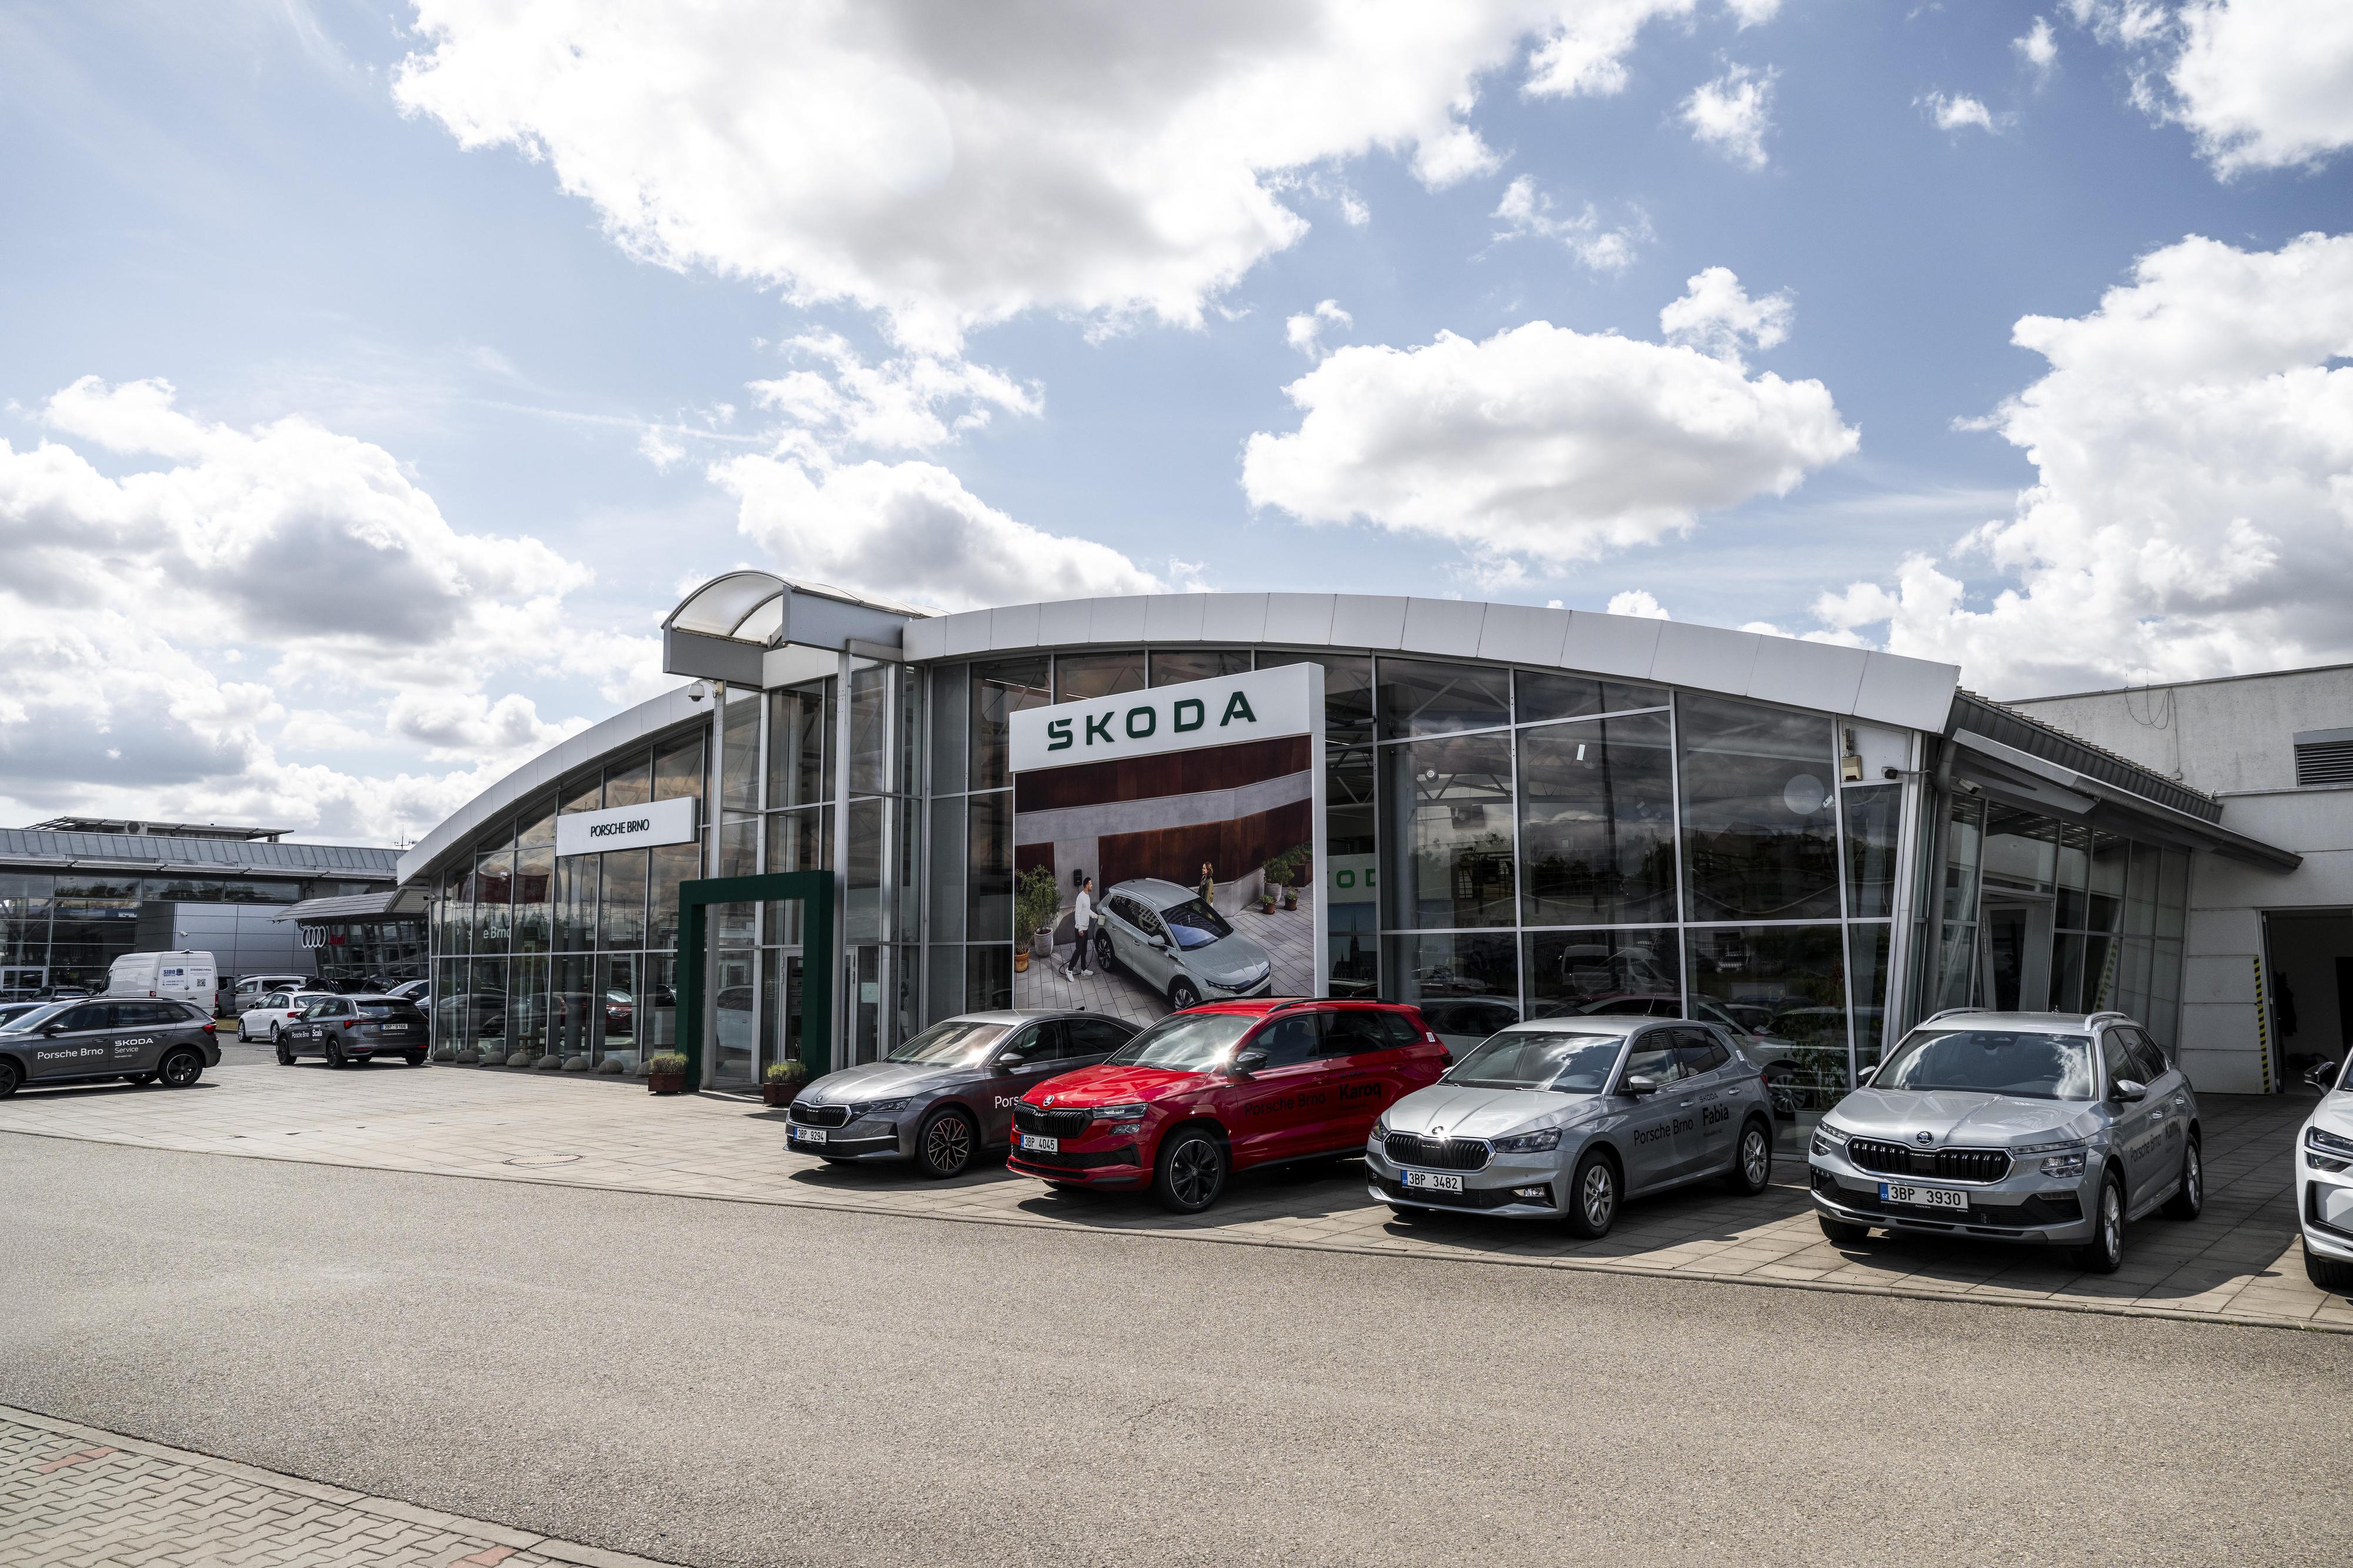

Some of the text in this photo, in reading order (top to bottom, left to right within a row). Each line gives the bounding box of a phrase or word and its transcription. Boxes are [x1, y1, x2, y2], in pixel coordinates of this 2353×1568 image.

[591, 819, 649, 838] PORSCHE BRNO
[37, 1048, 104, 1060] Porsche Brno
[1339, 1082, 1382, 1101] Karoq
[1244, 1092, 1326, 1117] Porsche Brno
[1702, 1103, 1729, 1126] Fabia
[798, 1129, 824, 1141] 3BP 9294
[1634, 1119, 1694, 1146] Porsche Brno
[1025, 1136, 1055, 1150] 3BP 4045
[2130, 1139, 2149, 1165] Porsche
[2151, 1134, 2161, 1151] Brno
[1409, 1173, 1458, 1189] 3BP 3482
[1891, 1186, 1961, 1206] 3BP 3930
